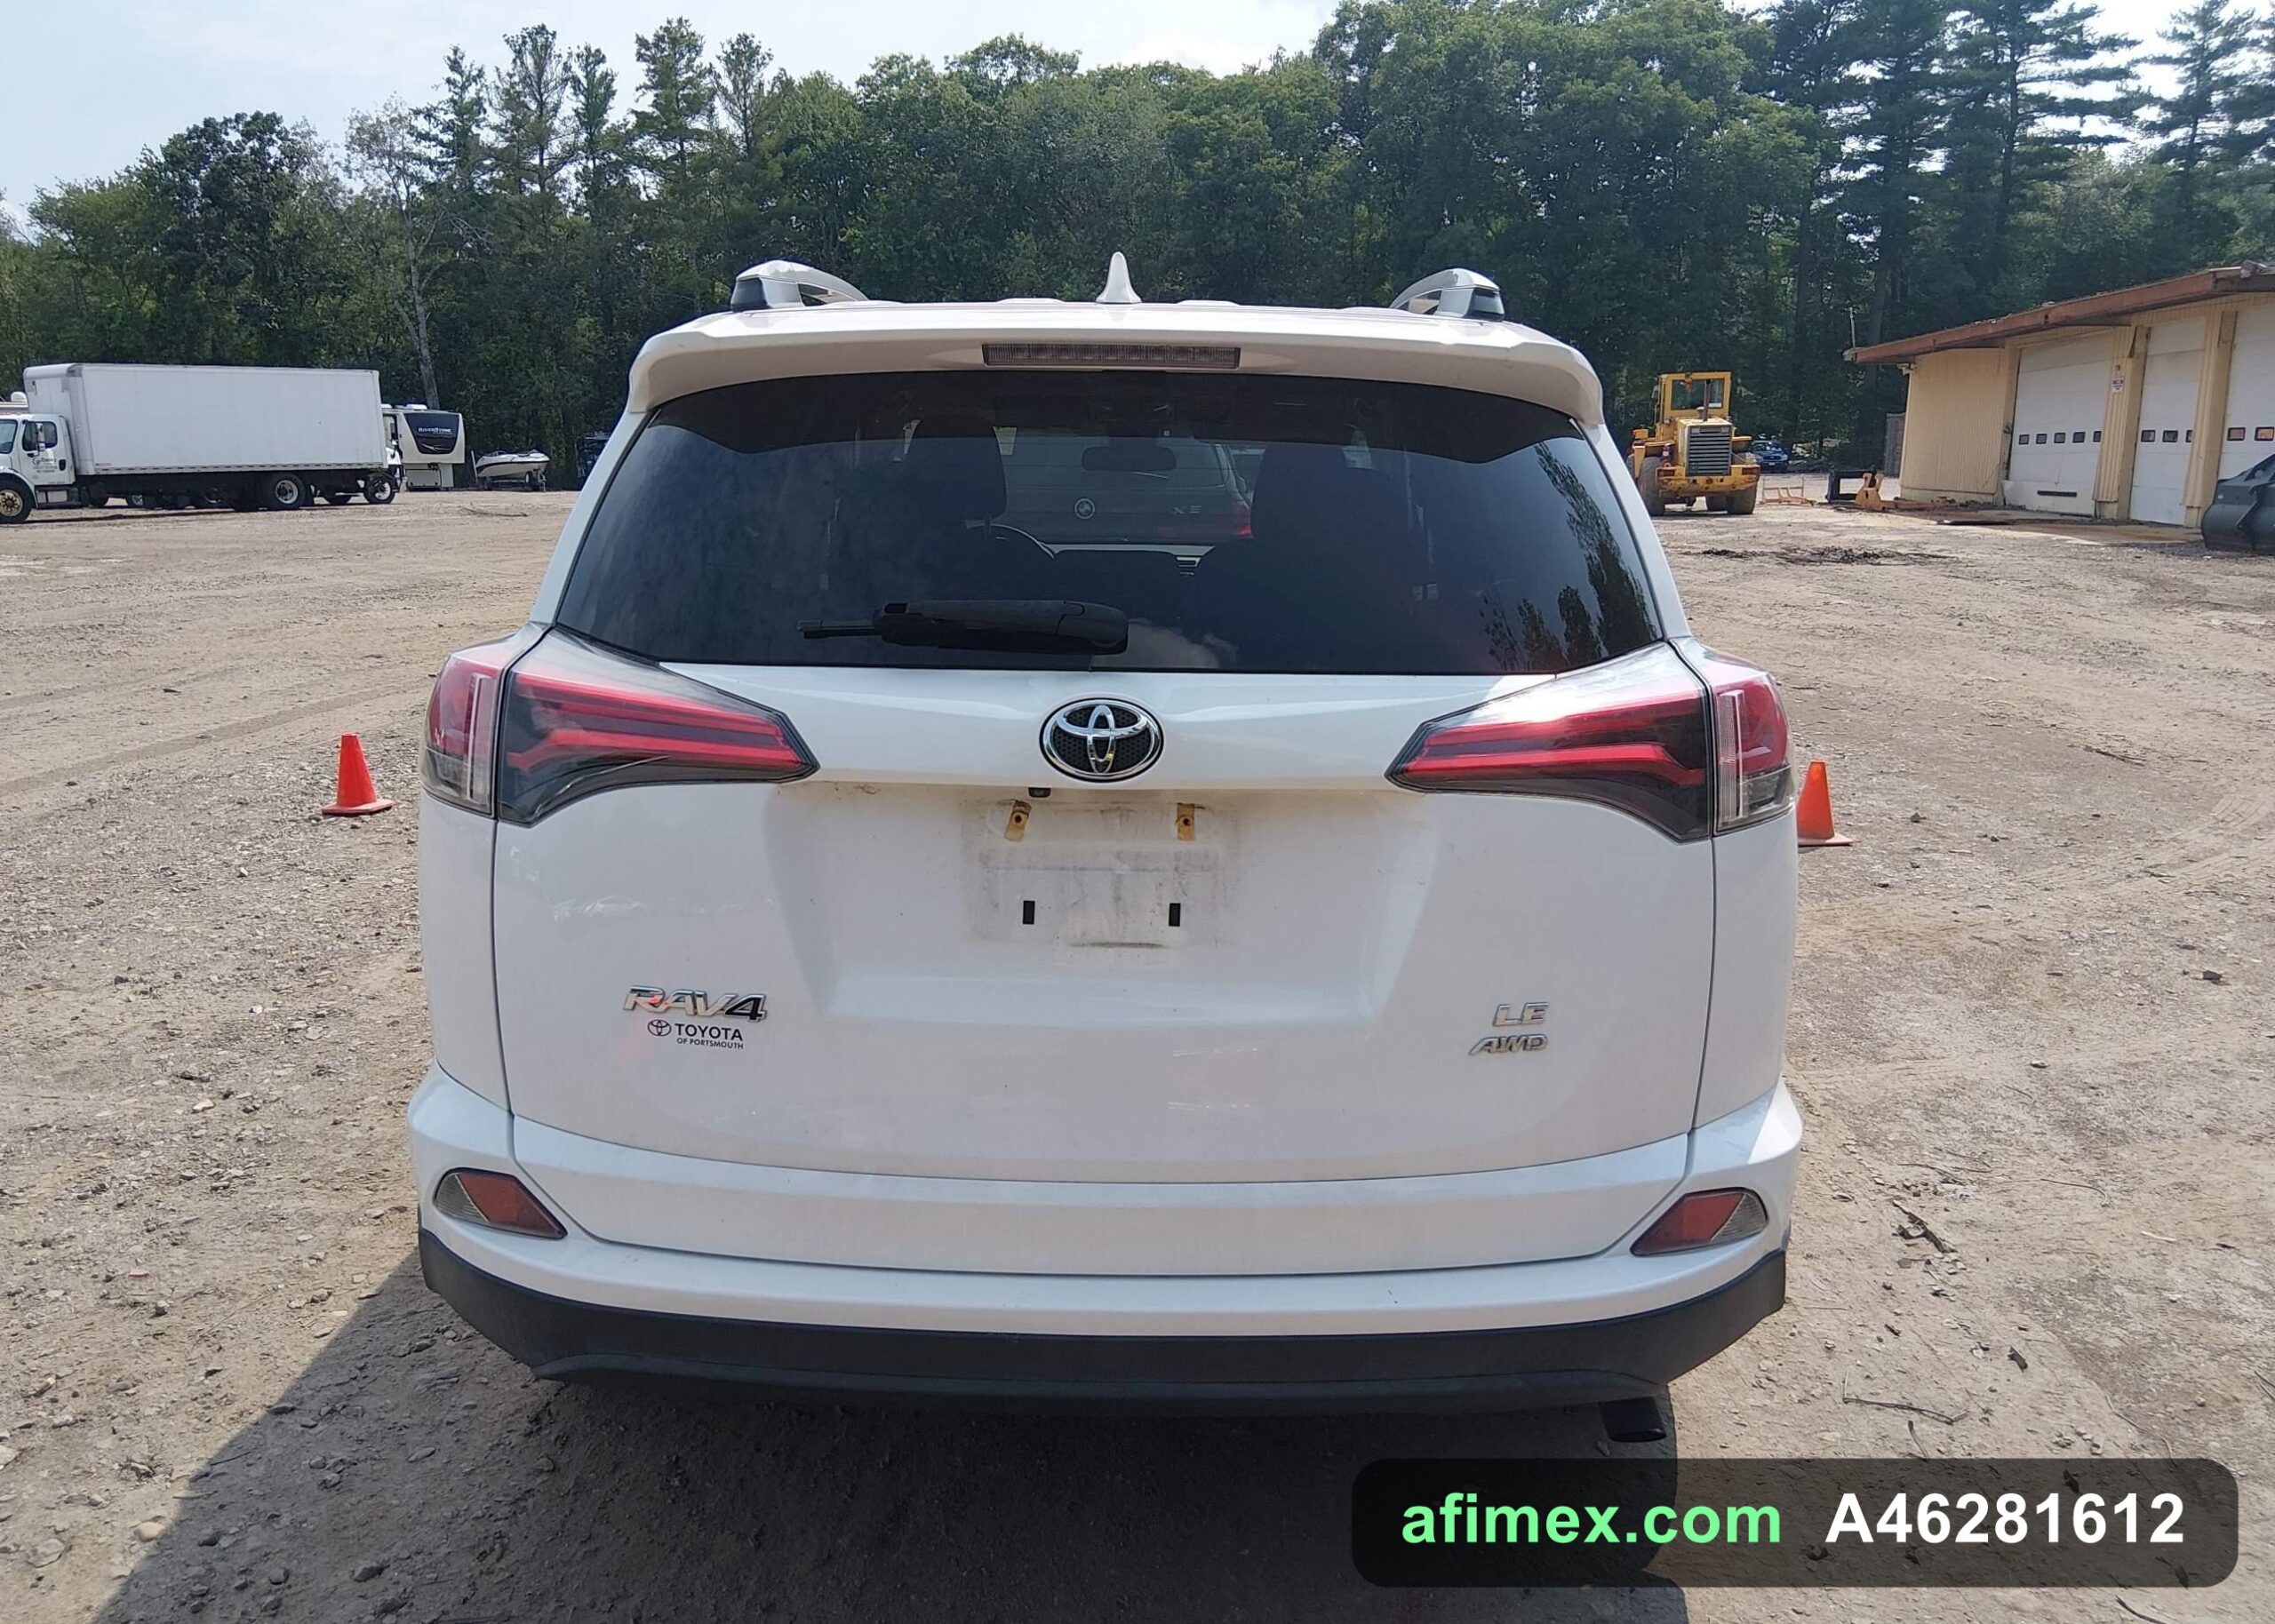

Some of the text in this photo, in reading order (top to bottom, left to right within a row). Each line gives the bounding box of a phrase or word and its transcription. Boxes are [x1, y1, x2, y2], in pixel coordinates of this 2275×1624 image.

[623, 985, 767, 1023] RAV4
[1492, 1001, 1550, 1026] LE
[675, 1023, 743, 1040] TOYOTA
[690, 1039, 744, 1049] PORTSMOUTH
[1468, 1033, 1548, 1056] AWD
